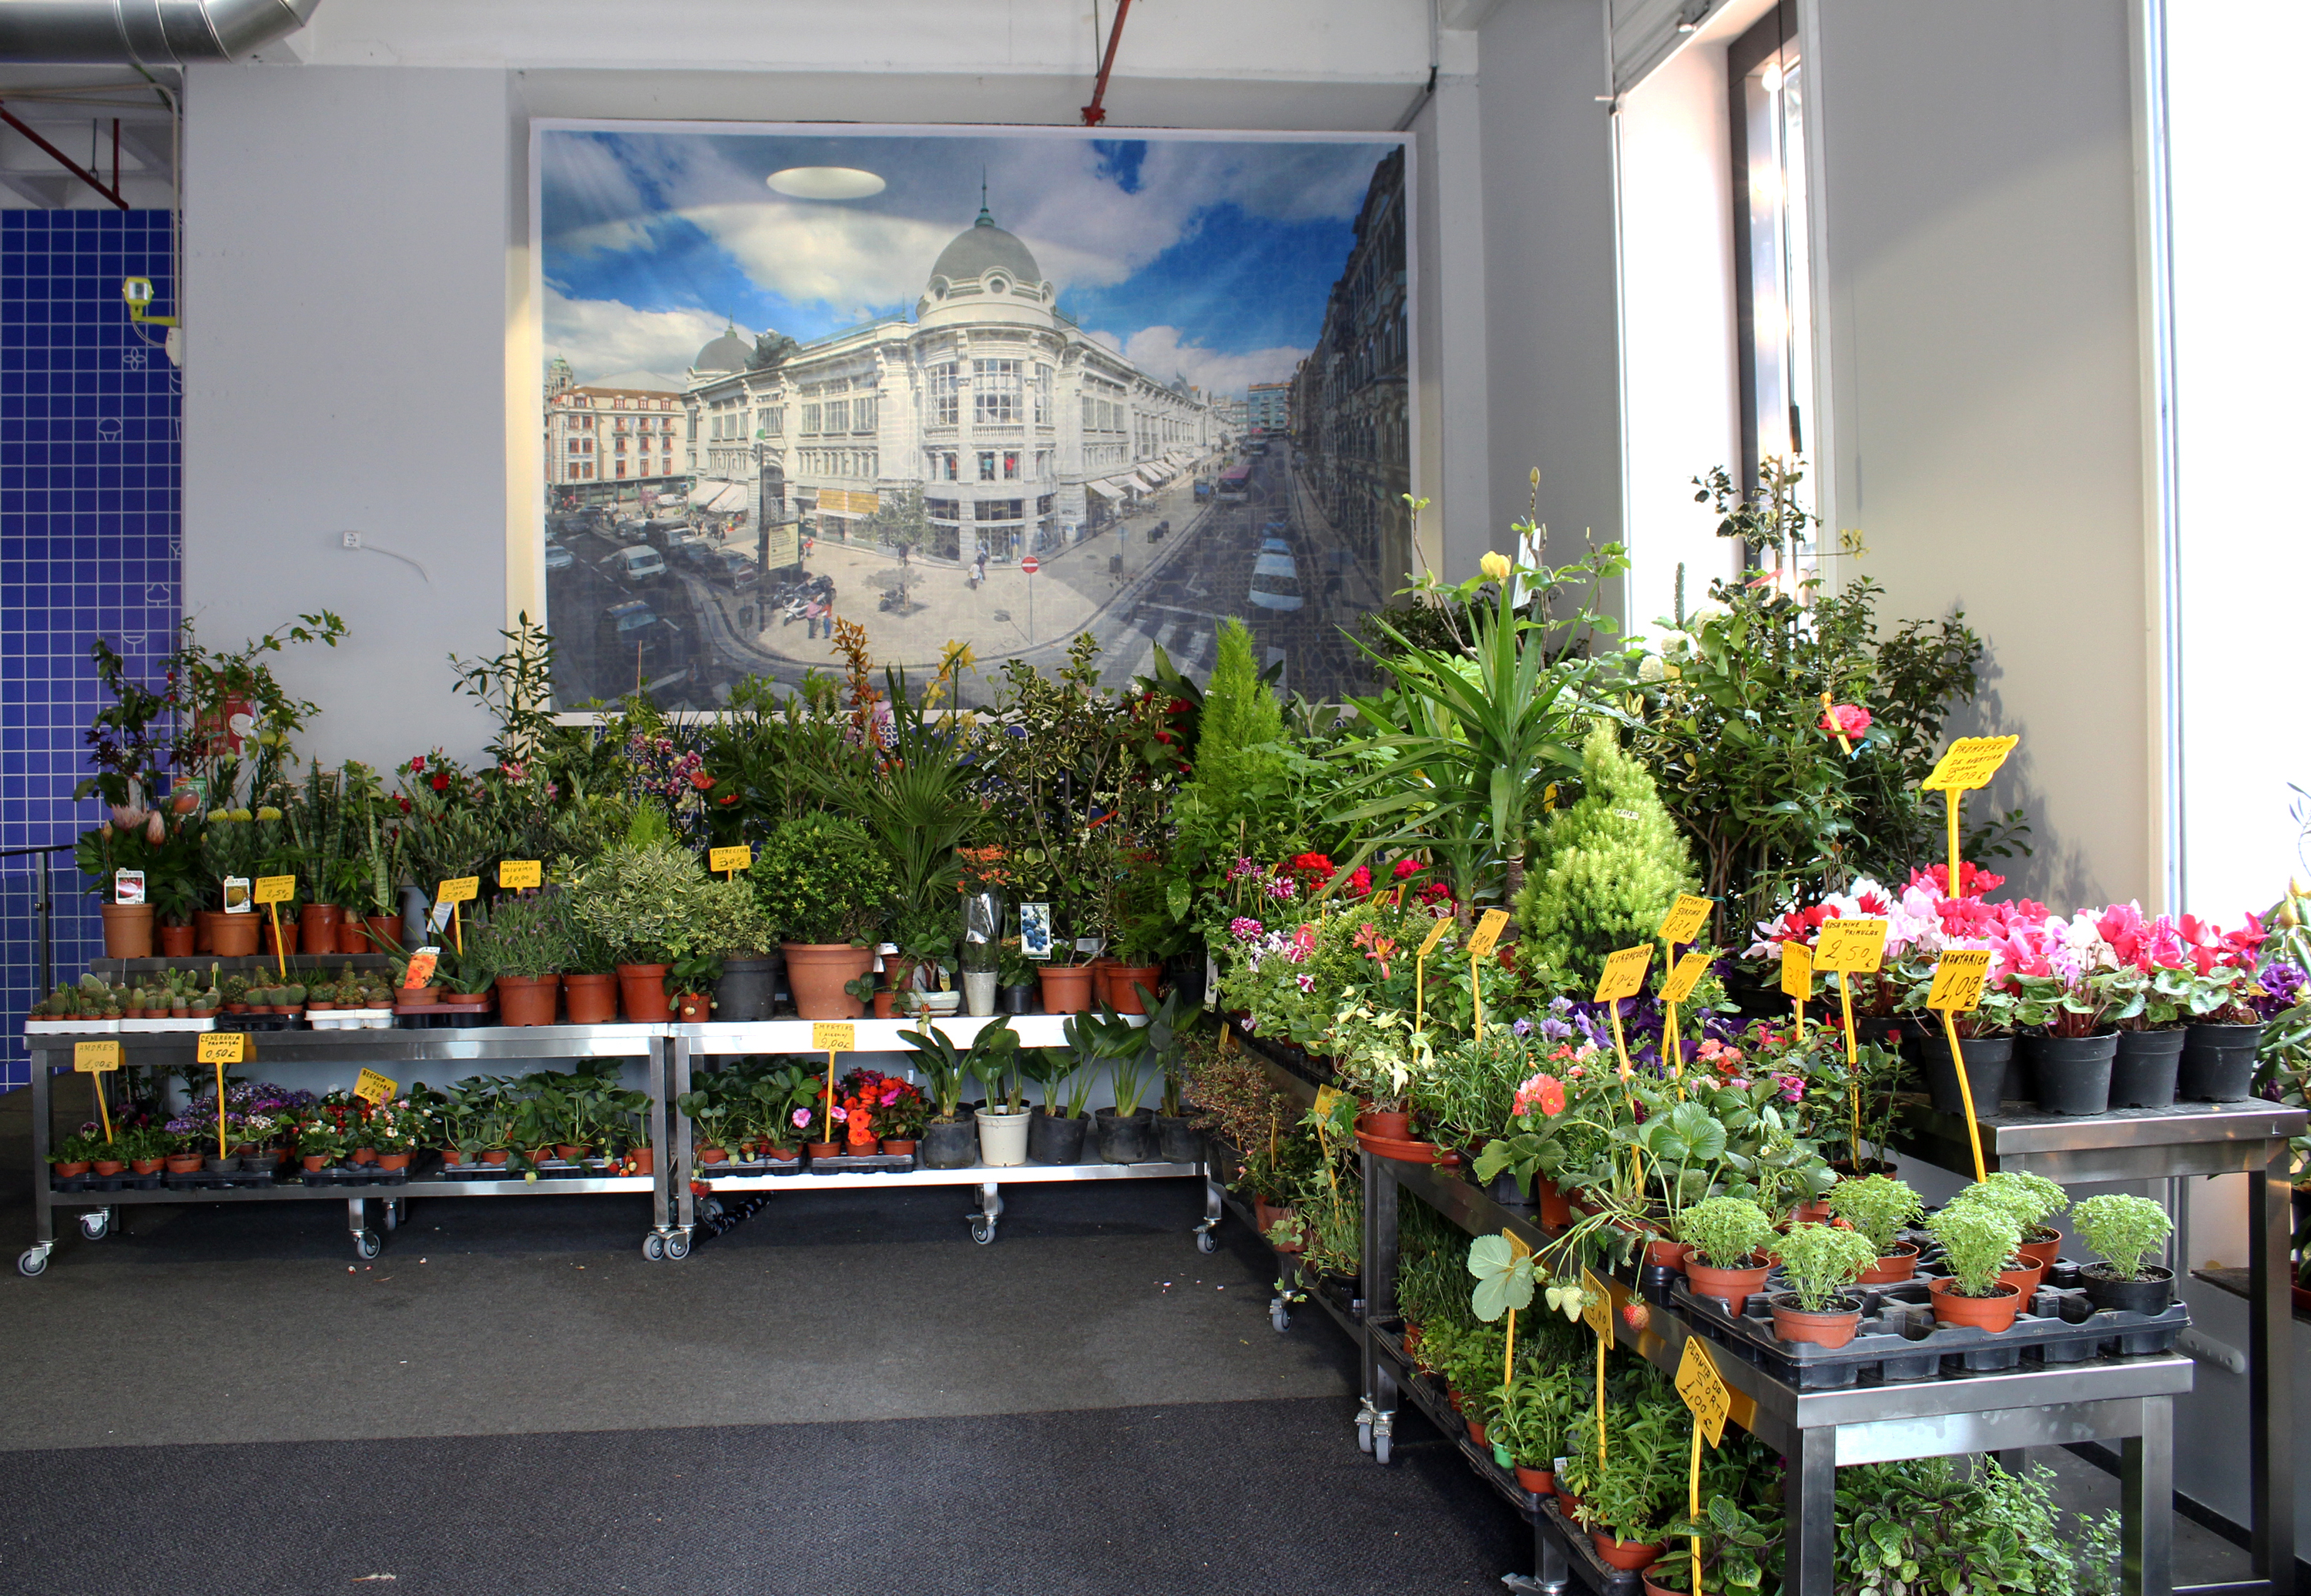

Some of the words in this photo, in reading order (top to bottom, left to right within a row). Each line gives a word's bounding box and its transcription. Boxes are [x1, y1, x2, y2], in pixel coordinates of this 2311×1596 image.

[1953, 743, 2003, 755] PROMOÇÃO
[1941, 953, 1990, 968] MANJARICO
[78, 1043, 115, 1053] AMORES
[206, 1048, 236, 1061] 0,50€
[1687, 1341, 1711, 1379] PLANTA
[1712, 1380, 1722, 1395] DA
[1696, 1371, 1725, 1423] SORTE
